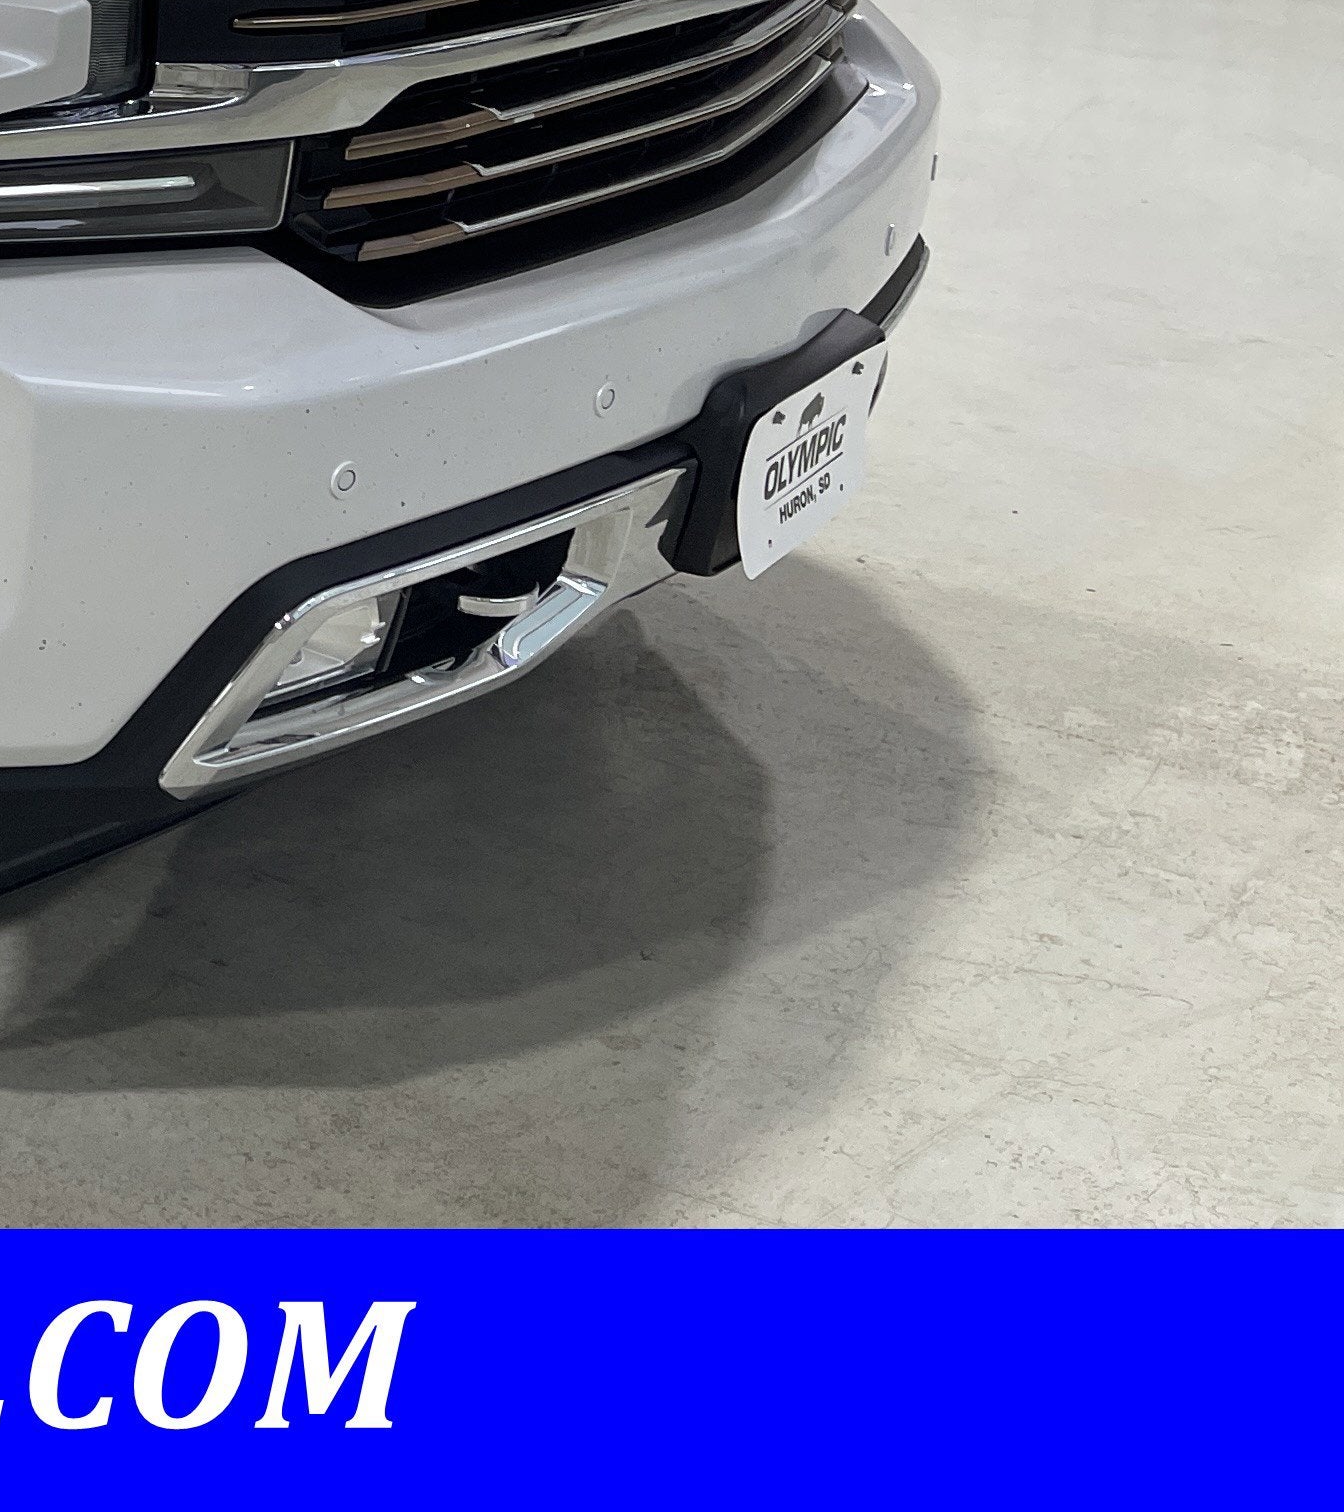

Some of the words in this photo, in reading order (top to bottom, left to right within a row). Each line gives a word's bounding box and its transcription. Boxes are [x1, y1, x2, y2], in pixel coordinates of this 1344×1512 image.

[763, 414, 847, 501] OLYMPIC
[779, 485, 817, 524] HURON,
[819, 472, 831, 494] SD
